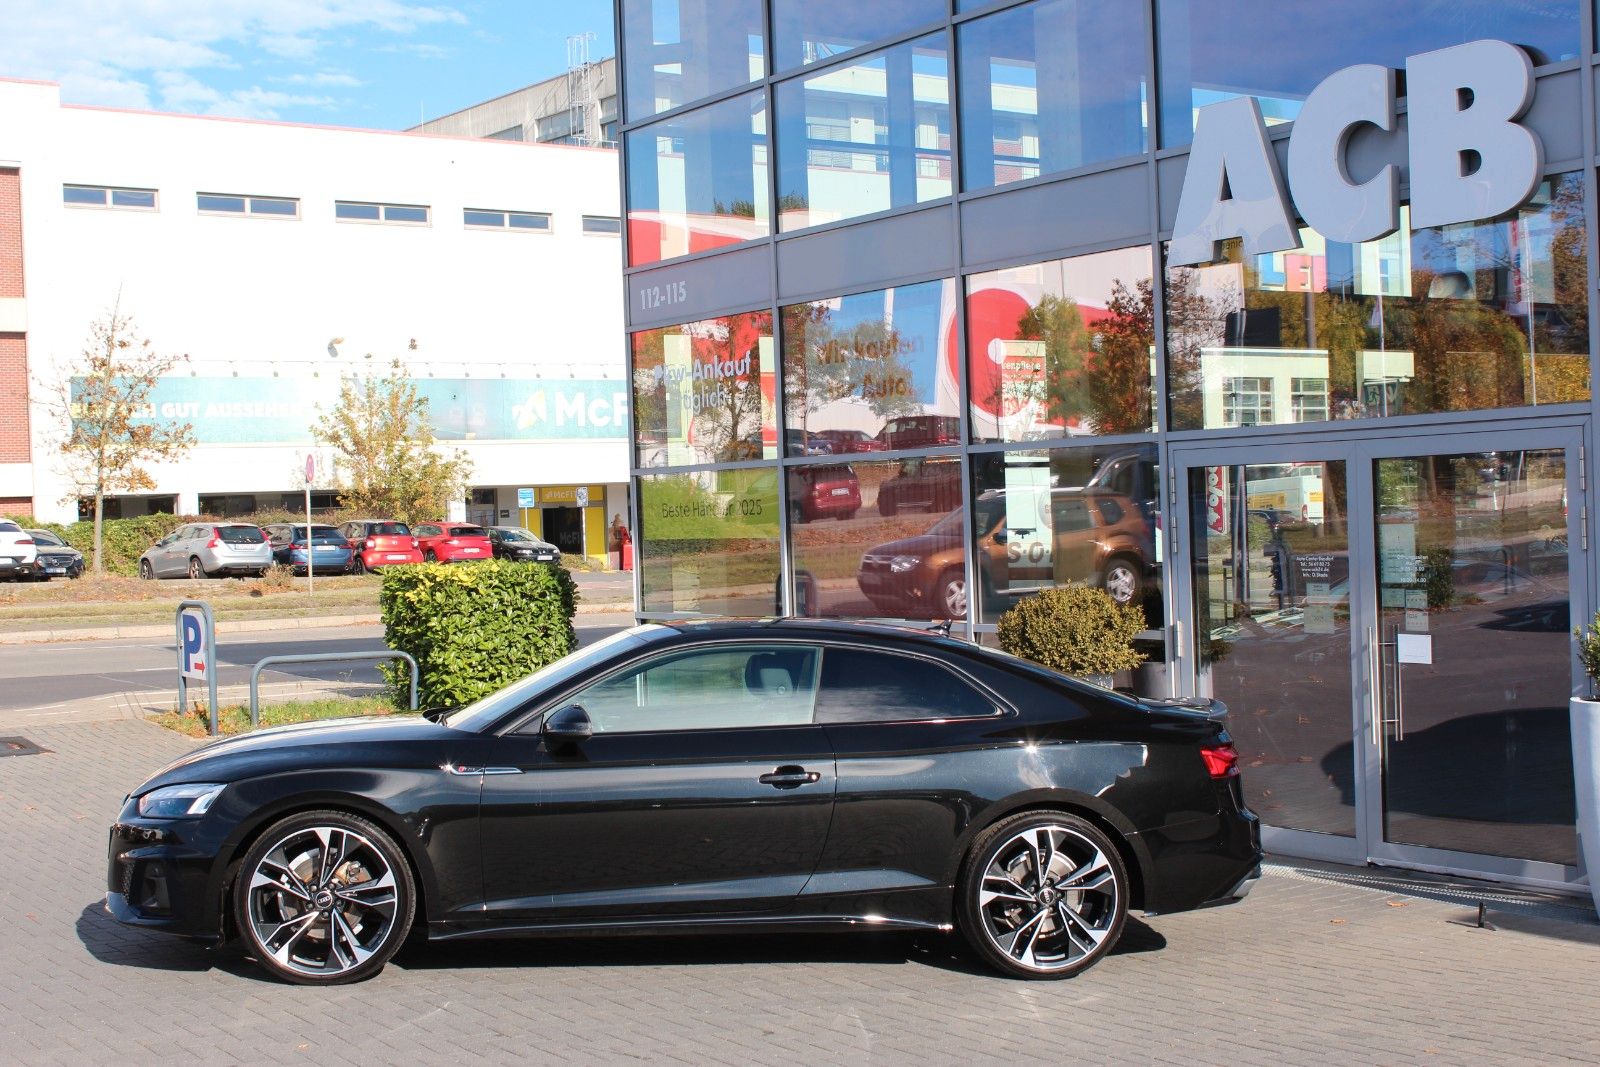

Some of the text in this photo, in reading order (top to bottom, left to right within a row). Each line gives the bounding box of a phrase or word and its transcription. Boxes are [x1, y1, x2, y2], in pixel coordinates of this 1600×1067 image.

[1167, 39, 1543, 266] ACB
[640, 281, 687, 310] 112-115
[161, 402, 200, 418] GUT
[662, 502, 690, 518] Beste
[183, 615, 202, 672] P
